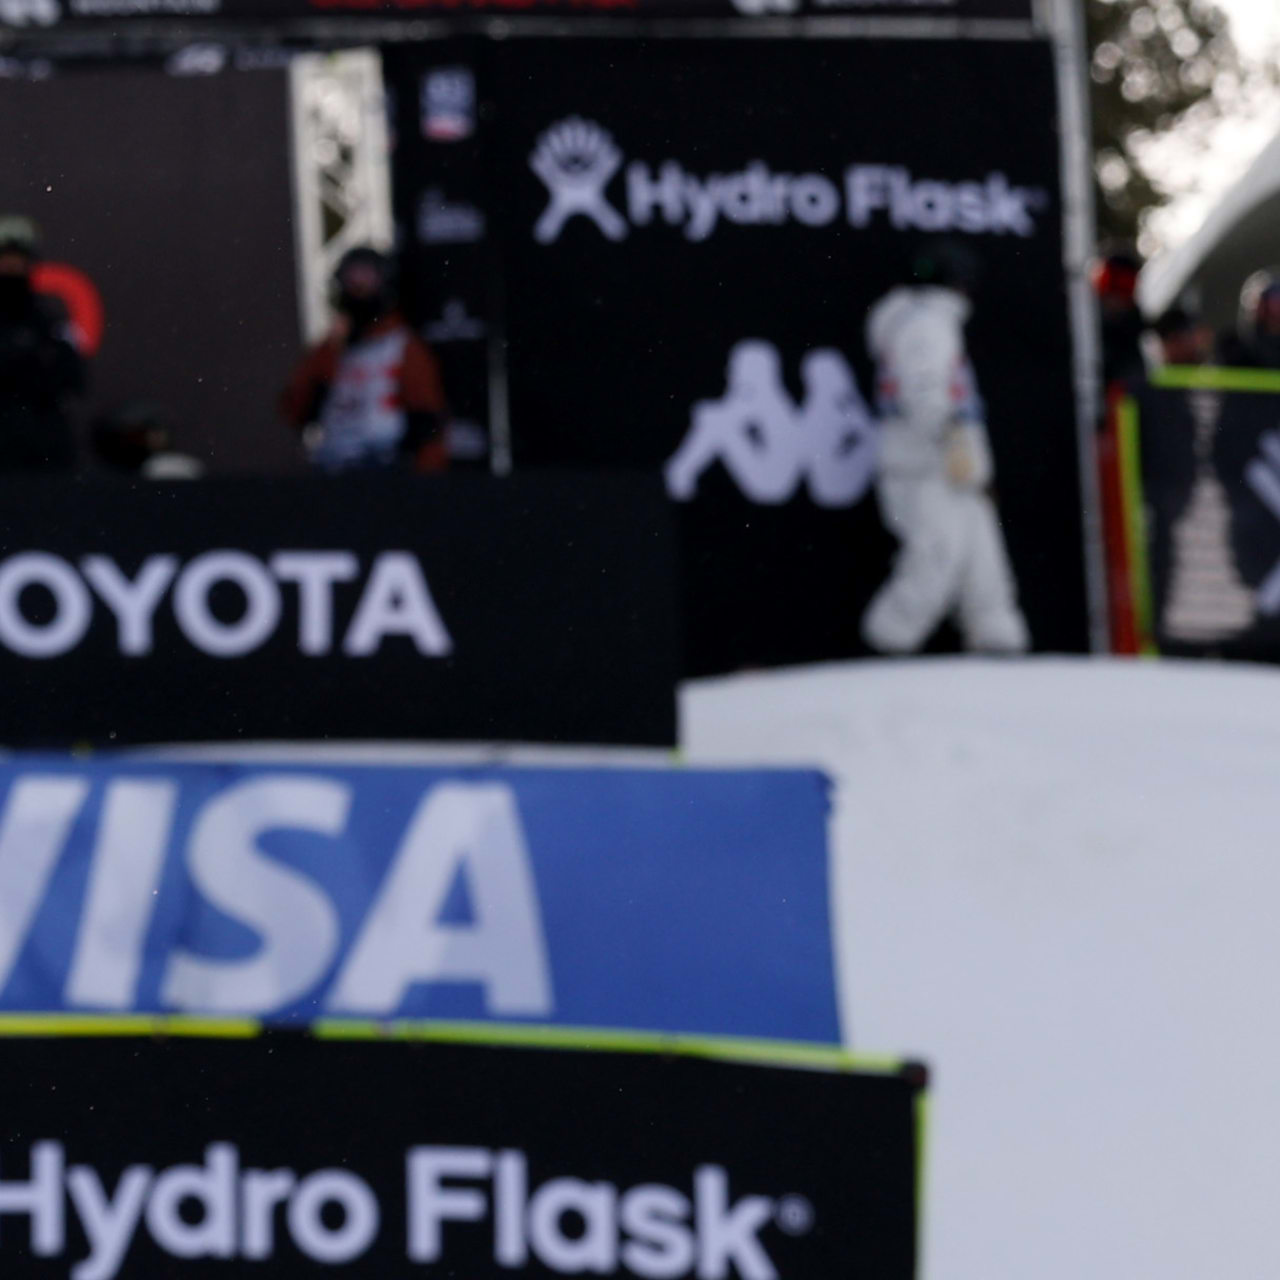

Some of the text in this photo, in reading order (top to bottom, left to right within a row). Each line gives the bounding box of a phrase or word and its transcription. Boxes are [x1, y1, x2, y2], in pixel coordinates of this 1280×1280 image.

[627, 158, 1034, 241] Hydro Flask
[404, 1144, 780, 1280] Flask
